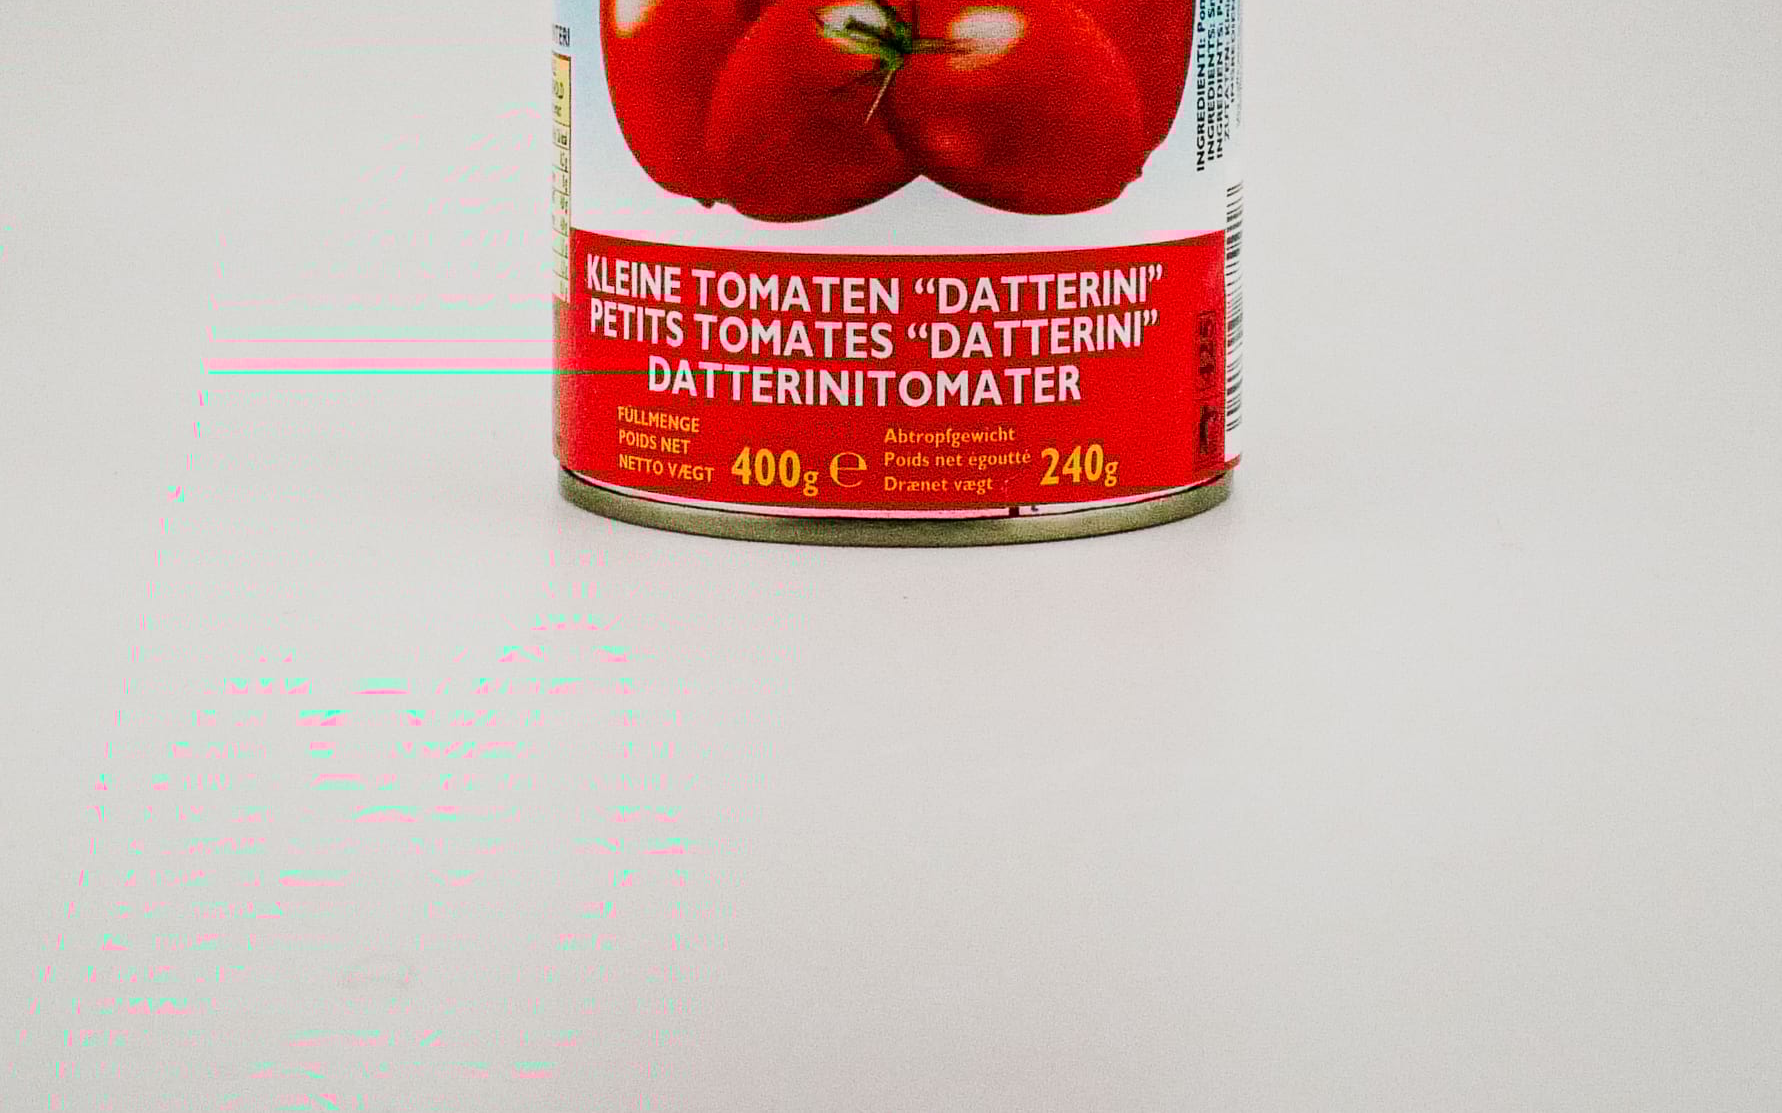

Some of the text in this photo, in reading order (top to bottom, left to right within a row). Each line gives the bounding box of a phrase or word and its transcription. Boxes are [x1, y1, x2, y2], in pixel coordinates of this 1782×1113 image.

[552, 23, 571, 47] TERI
[1196, 38, 1206, 173] INGREDIENTI:
[1207, 23, 1216, 161] INGREDIENTS:
[1216, 22, 1224, 159] INGREDIENTS:
[586, 253, 1163, 315] KLEINE TOMATEN “DATTERINI”
[590, 297, 1159, 359] PETITS TOMATES “DATTERINI”
[648, 354, 1081, 407] DATTERINITOMATER
[617, 405, 700, 433] FÜLLMENGE
[883, 427, 1016, 448] Abtropfgewicht
[618, 429, 691, 455] POIDS NET
[883, 448, 1032, 470] Poids net égoutté
[618, 453, 715, 483] NETTO VÆGT
[731, 445, 819, 497] 400g
[883, 475, 994, 495] Drænet vægt
[1040, 443, 1119, 487] 240g
